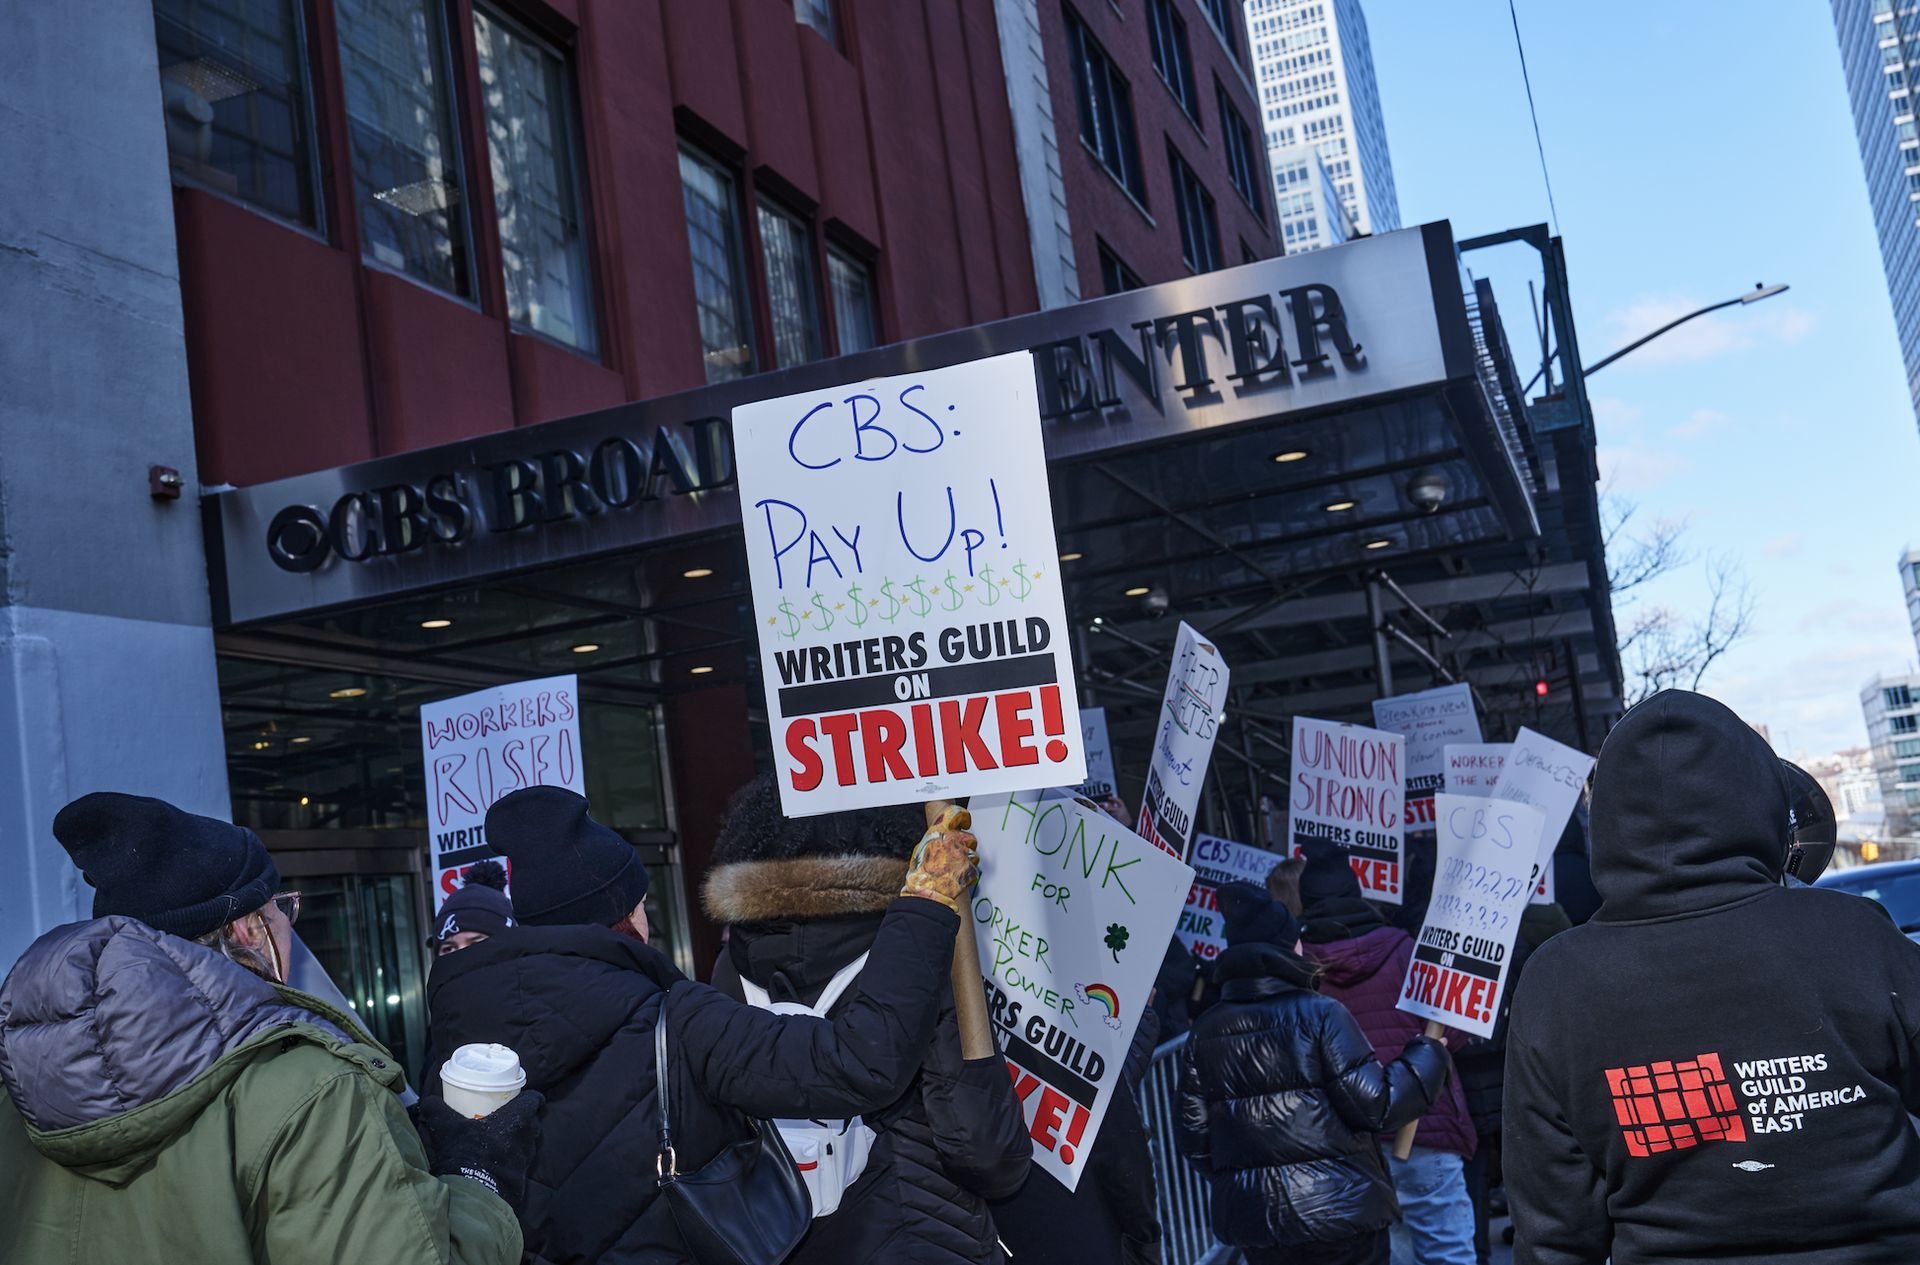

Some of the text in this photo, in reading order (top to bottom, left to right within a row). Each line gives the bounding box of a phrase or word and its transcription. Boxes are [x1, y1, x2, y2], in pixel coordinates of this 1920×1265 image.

[789, 385, 960, 469] CBS:
[330, 471, 467, 562] CBS
[774, 616, 1051, 685] WRITERS GUILD
[894, 673, 931, 700] ON
[427, 690, 574, 750] WORKERS
[785, 685, 1068, 792] STRIKE!
[1300, 728, 1399, 786] UNION
[1293, 772, 1397, 828] STRONG
[1454, 775, 1477, 786] THE
[1163, 796, 1189, 836] GUILD
[1294, 817, 1398, 850] WRITERS GUILD
[1450, 806, 1514, 849] CBS
[1001, 788, 1141, 904] HONK
[1197, 839, 1231, 864] CBS
[1232, 849, 1267, 875] NEWS
[1031, 873, 1071, 913] FOR
[1421, 925, 1505, 963] WRITERS GUILD
[992, 938, 1078, 1028] POWER
[1405, 961, 1497, 1023] STRIKE!
[1025, 1015, 1105, 1083] GUILD
[1733, 1054, 1828, 1079] WRITERS
[1741, 1076, 1806, 1097] GUILD
[1747, 1085, 1867, 1115] of AMERICA
[1751, 1113, 1804, 1134] EAST
